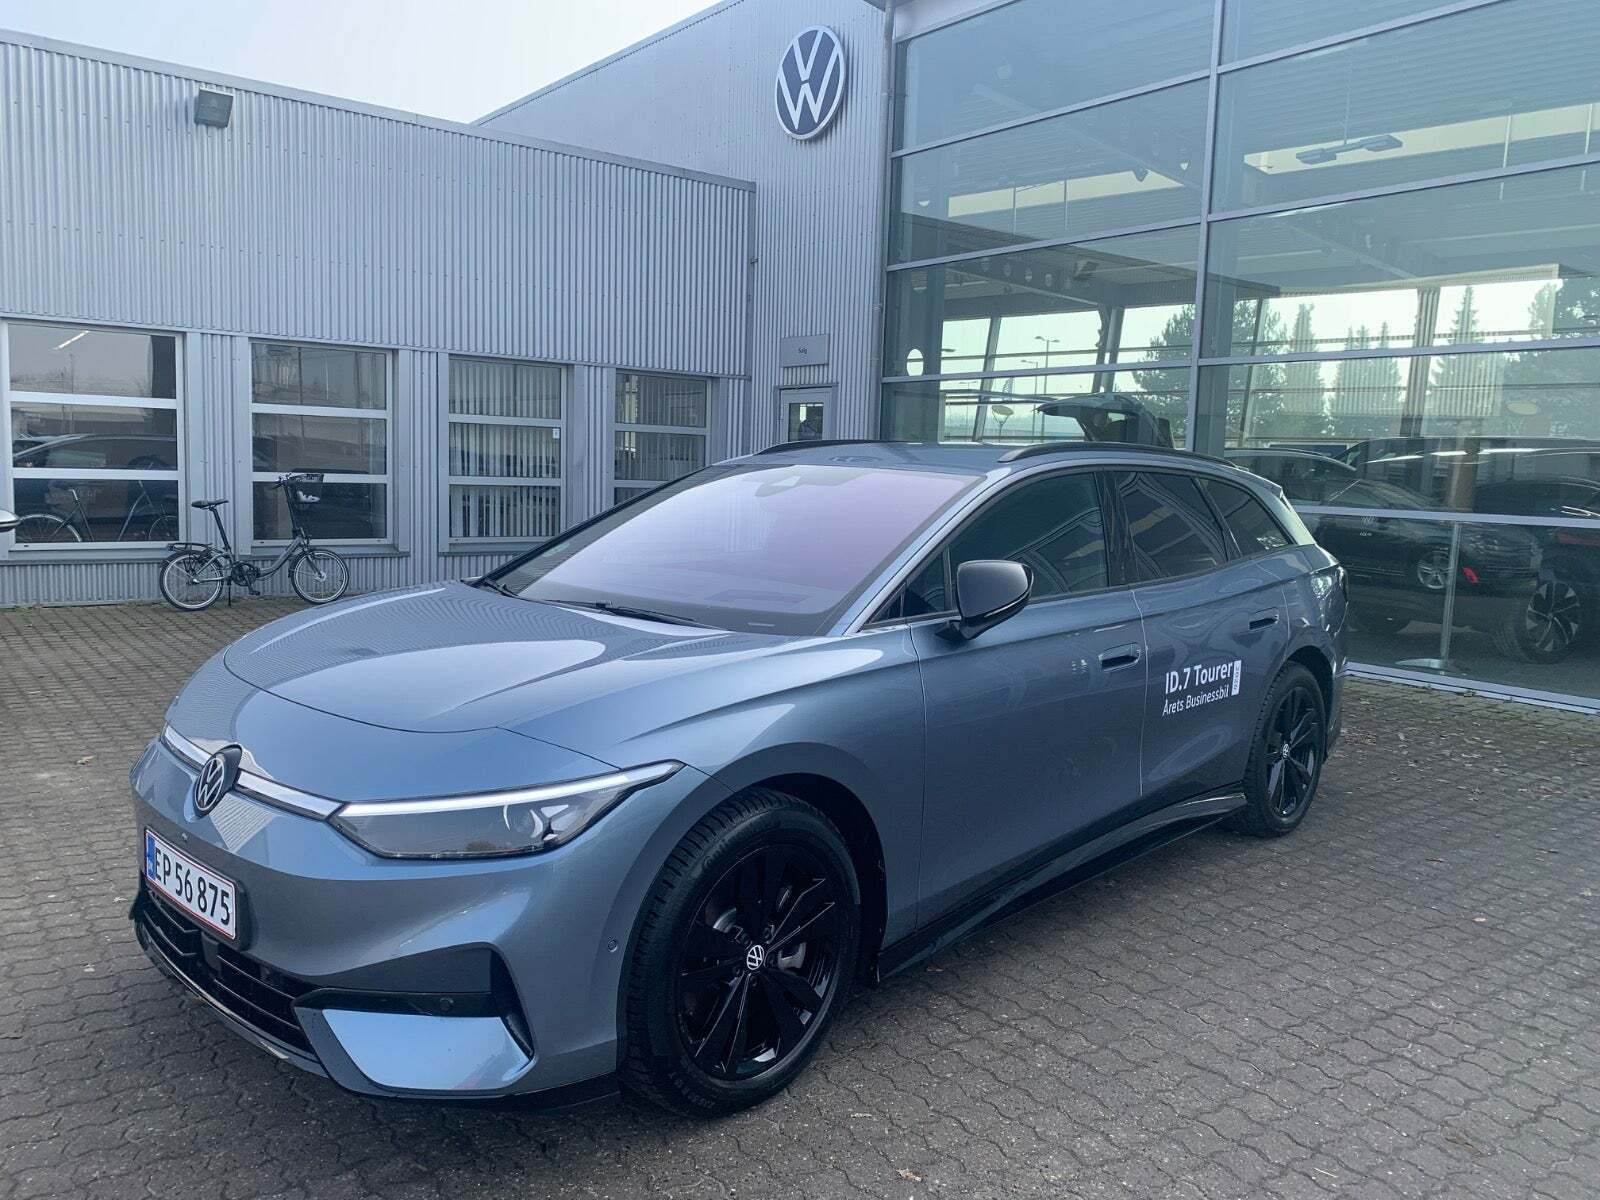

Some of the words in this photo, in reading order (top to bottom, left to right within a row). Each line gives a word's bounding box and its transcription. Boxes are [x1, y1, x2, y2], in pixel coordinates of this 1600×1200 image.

[776, 27, 844, 138] VW
[1165, 667, 1190, 694] ID.7
[1194, 661, 1233, 685] Tourer
[1185, 684, 1229, 709] Businessbil
[195, 758, 224, 810] VW
[155, 847, 171, 885] EP
[175, 861, 193, 903] 56
[197, 876, 230, 926] 875
